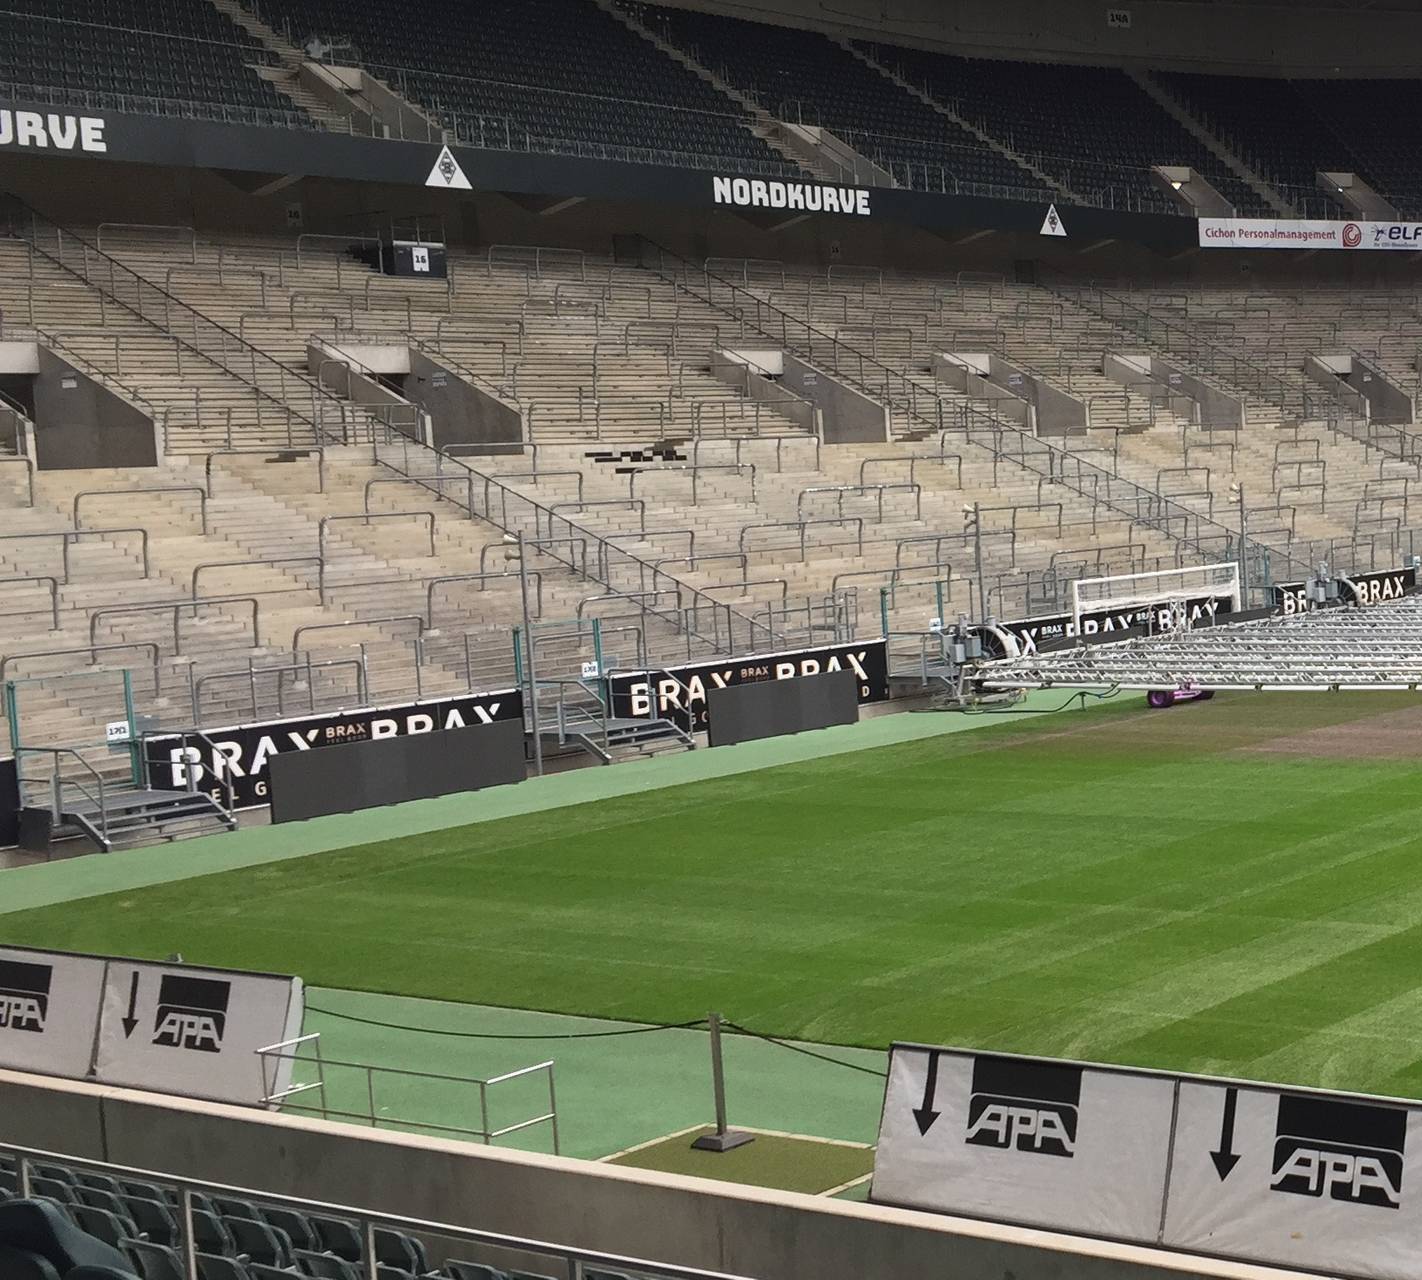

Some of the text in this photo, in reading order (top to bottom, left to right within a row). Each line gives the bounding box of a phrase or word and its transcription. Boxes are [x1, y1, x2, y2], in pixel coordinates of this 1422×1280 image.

[713, 177, 871, 215] NORDKURVE
[1205, 227, 1336, 241] Cichon Personalmanagement
[415, 255, 427, 264] 16
[1357, 576, 1405, 606] BRAX
[630, 670, 733, 716] BRAX
[741, 666, 769, 679] BRAX
[170, 729, 320, 787] BRAX
[325, 722, 366, 738] BRAX
[152, 1011, 222, 1050] APA
[966, 1103, 1075, 1156] APA
[1271, 1147, 1400, 1207] APA
